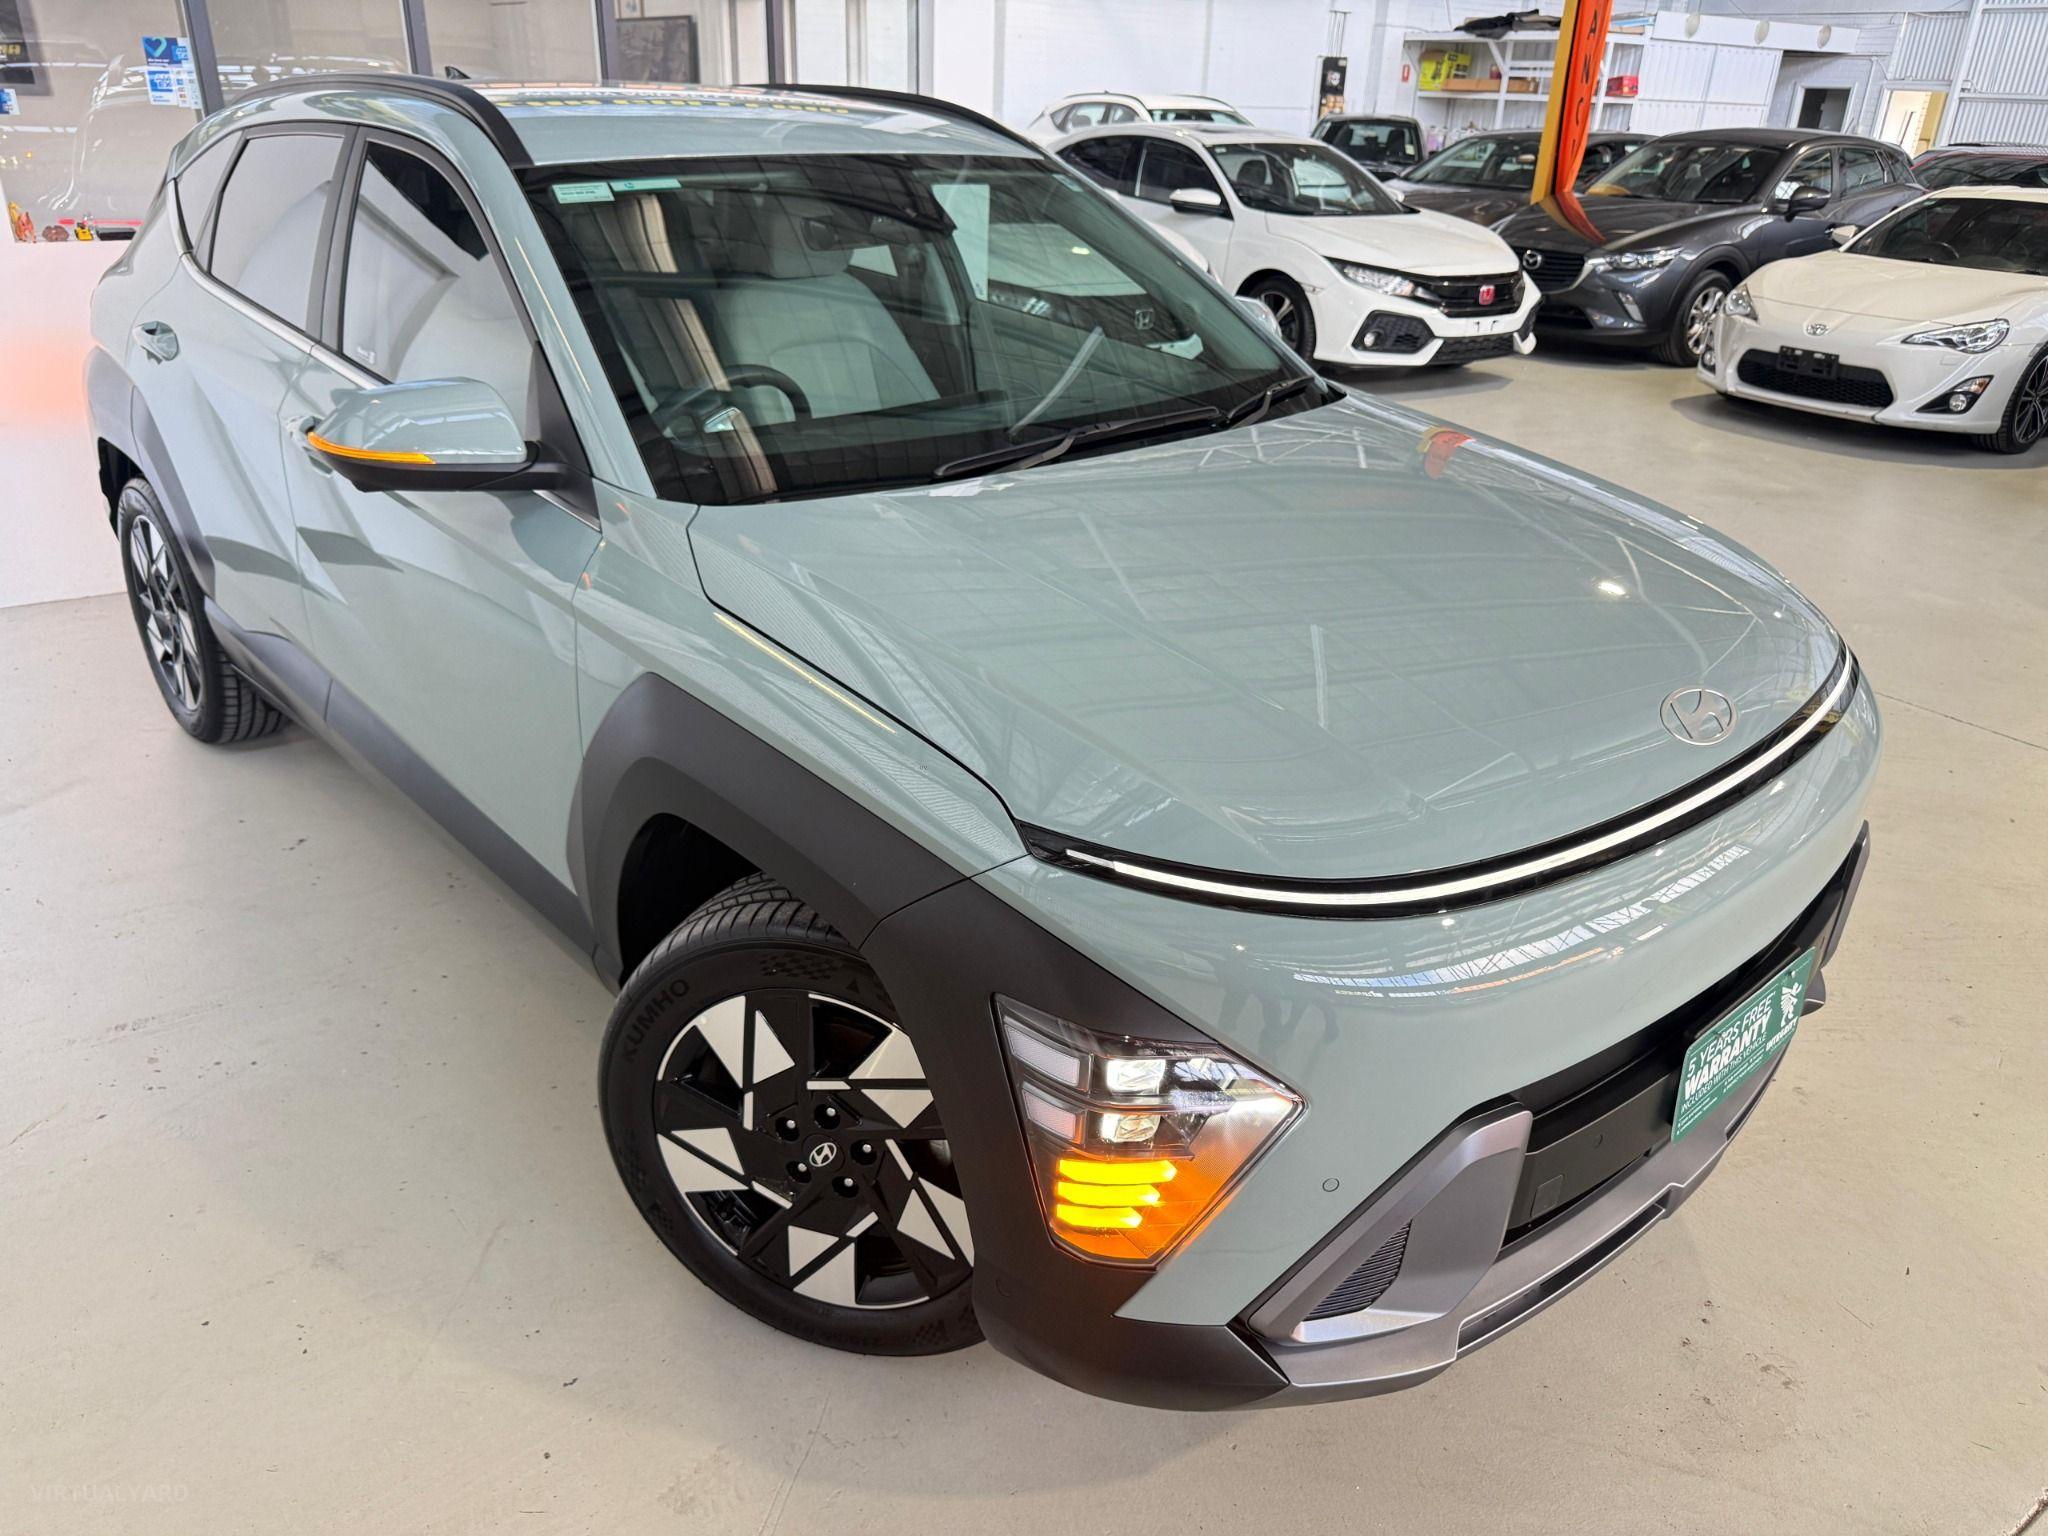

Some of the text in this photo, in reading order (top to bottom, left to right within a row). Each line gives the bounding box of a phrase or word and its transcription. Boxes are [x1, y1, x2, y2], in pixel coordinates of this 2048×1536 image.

[623, 979, 690, 1063] KUMHO
[1684, 1008, 1772, 1100] WARRANTY
[1687, 1057, 1697, 1077] 5
[1700, 1021, 1741, 1067] YEARS
[1680, 1080, 1713, 1114] INCLUDED
[1713, 1065, 1729, 1085] WITH
[1730, 1055, 1742, 1069] THIS
[1743, 1031, 1767, 1058] VEHICLE
